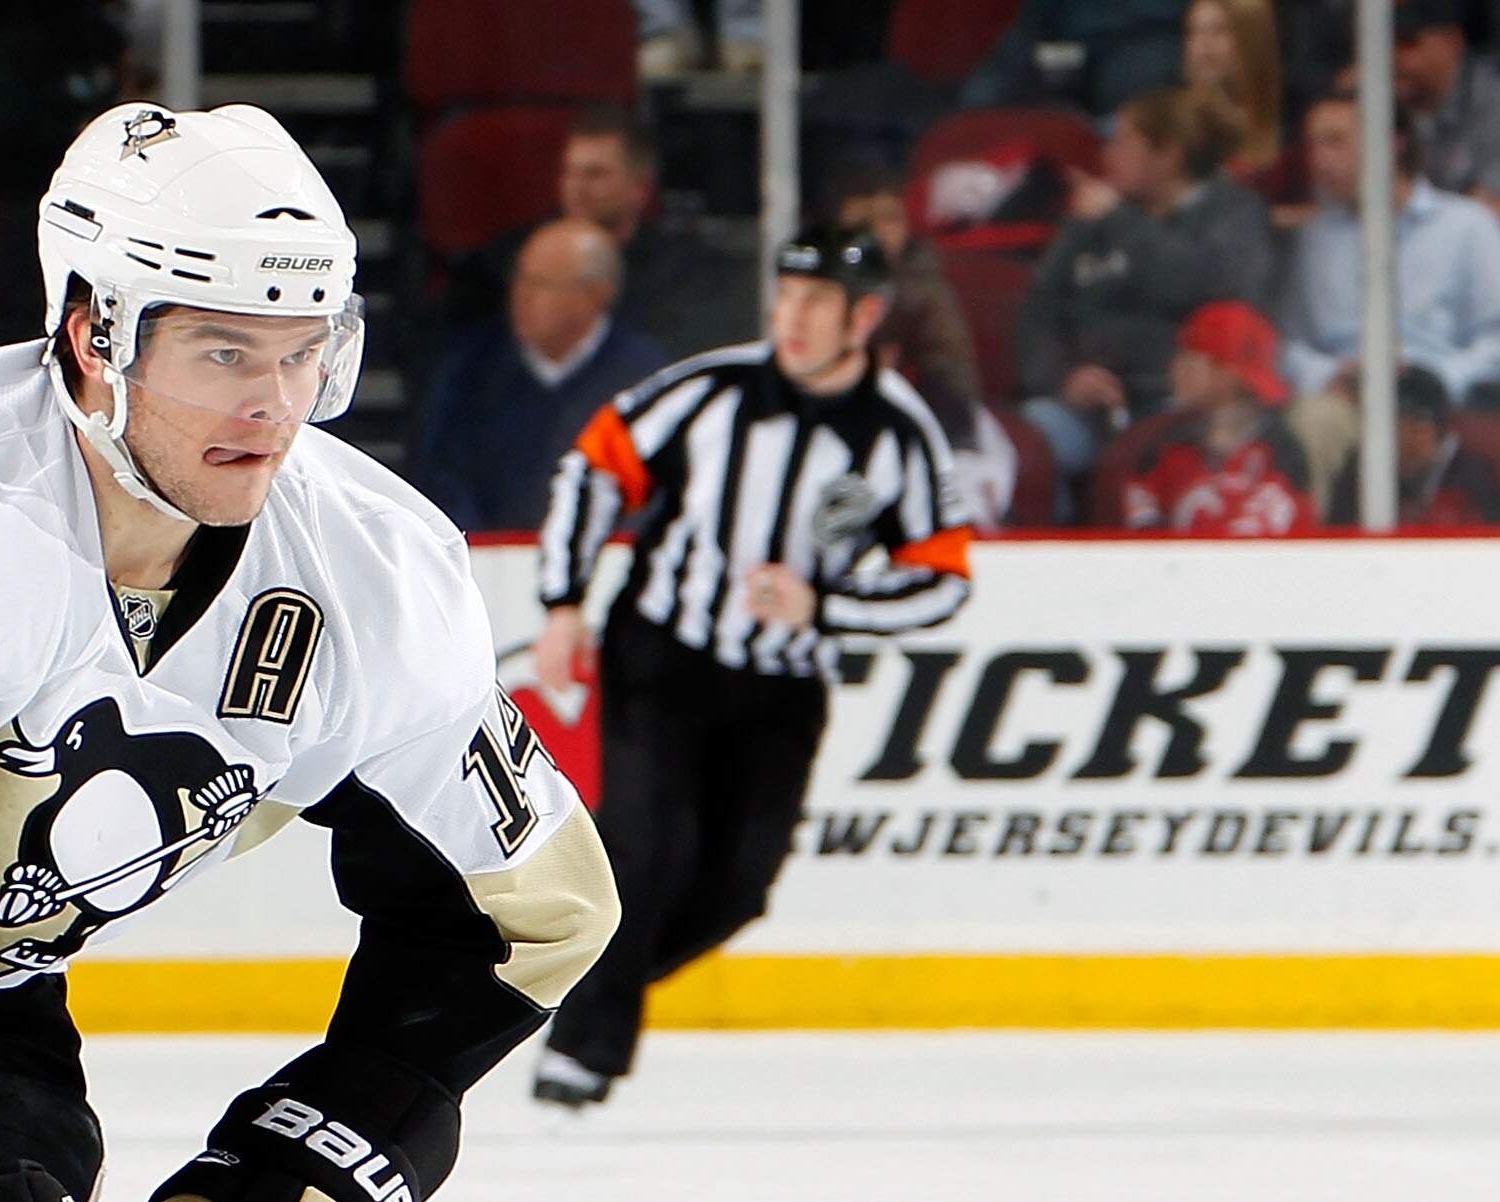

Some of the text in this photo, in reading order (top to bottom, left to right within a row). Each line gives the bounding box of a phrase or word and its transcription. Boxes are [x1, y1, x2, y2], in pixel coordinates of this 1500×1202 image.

[260, 256, 334, 272] BAUER
[129, 605, 151, 630] NHL
[217, 586, 325, 726] A
